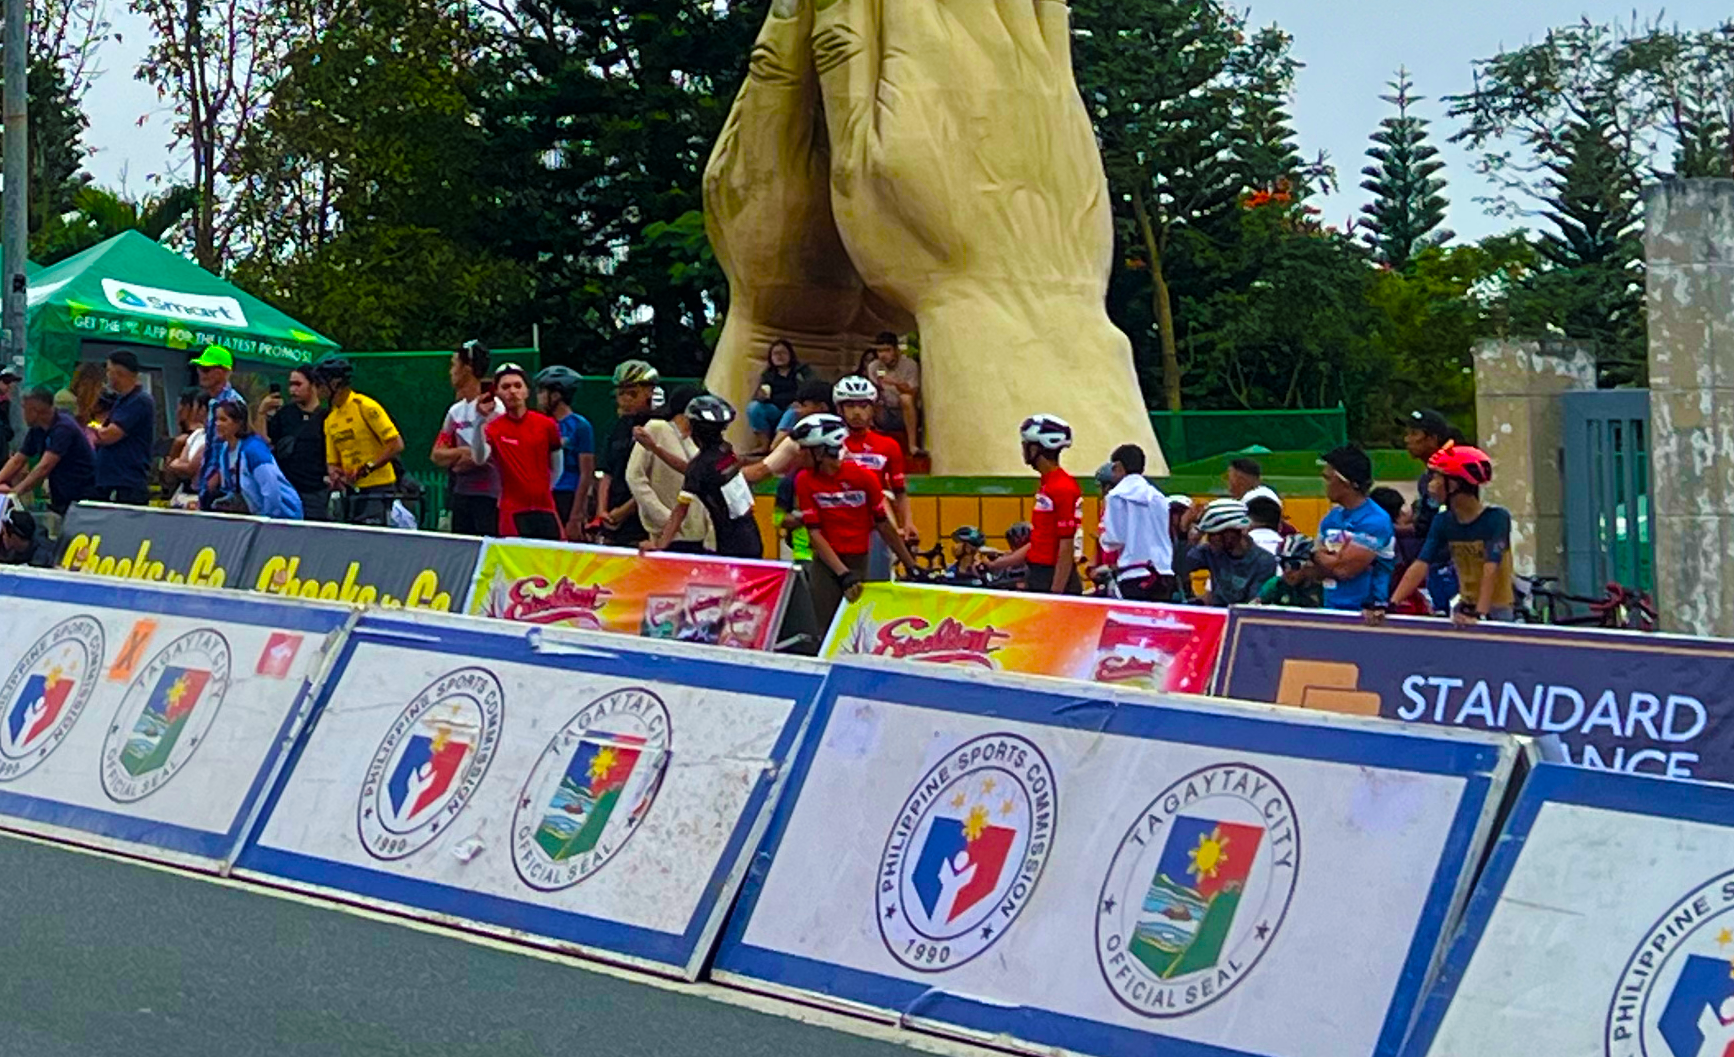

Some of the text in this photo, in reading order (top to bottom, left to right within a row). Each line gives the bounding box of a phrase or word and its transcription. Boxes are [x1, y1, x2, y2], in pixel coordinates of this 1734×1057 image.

[73, 315, 96, 329] GET
[99, 317, 120, 333] THE
[169, 328, 194, 344] FOR
[217, 335, 257, 353] LATEST
[146, 295, 236, 322] Smart
[364, 694, 432, 798] PHILIPPINE
[436, 674, 489, 697] SPORTS
[1397, 674, 1708, 742] STANDARD
[374, 833, 408, 854] 1990
[880, 740, 1051, 919] PHILIPPINE SPORTS COMMISSION
[1129, 769, 1293, 869] TAGAYTAY CITY
[518, 825, 614, 885] OFFICIAL SEAL
[904, 938, 951, 964] 1990
[1105, 933, 1244, 1008] OFFICIAL SEAL
[1613, 894, 1712, 1042] PHILIPPINE
